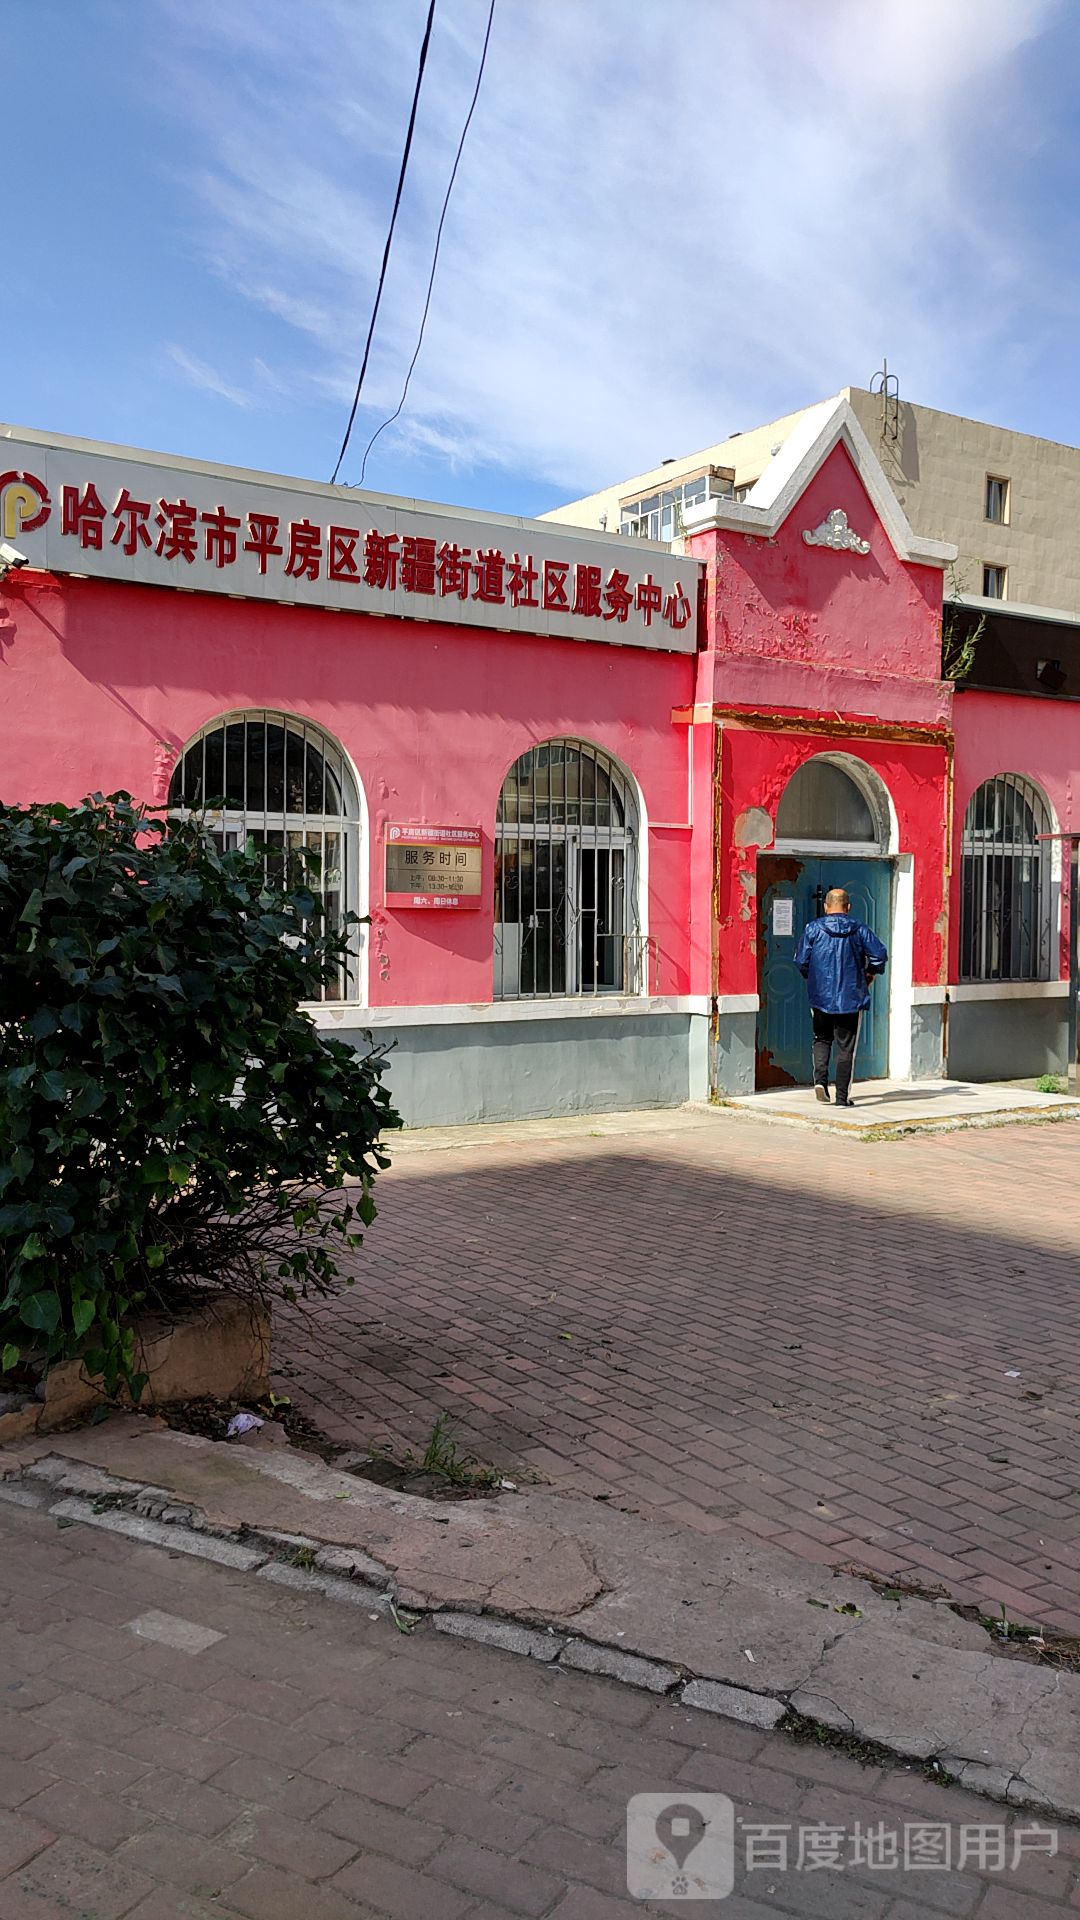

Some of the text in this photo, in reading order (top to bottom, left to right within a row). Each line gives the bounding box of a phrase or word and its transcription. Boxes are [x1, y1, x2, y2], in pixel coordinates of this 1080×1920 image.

[61, 482, 691, 629] 哈尔滨市平房区新疆街道社区服务中心
[405, 850, 467, 867] 服务时间
